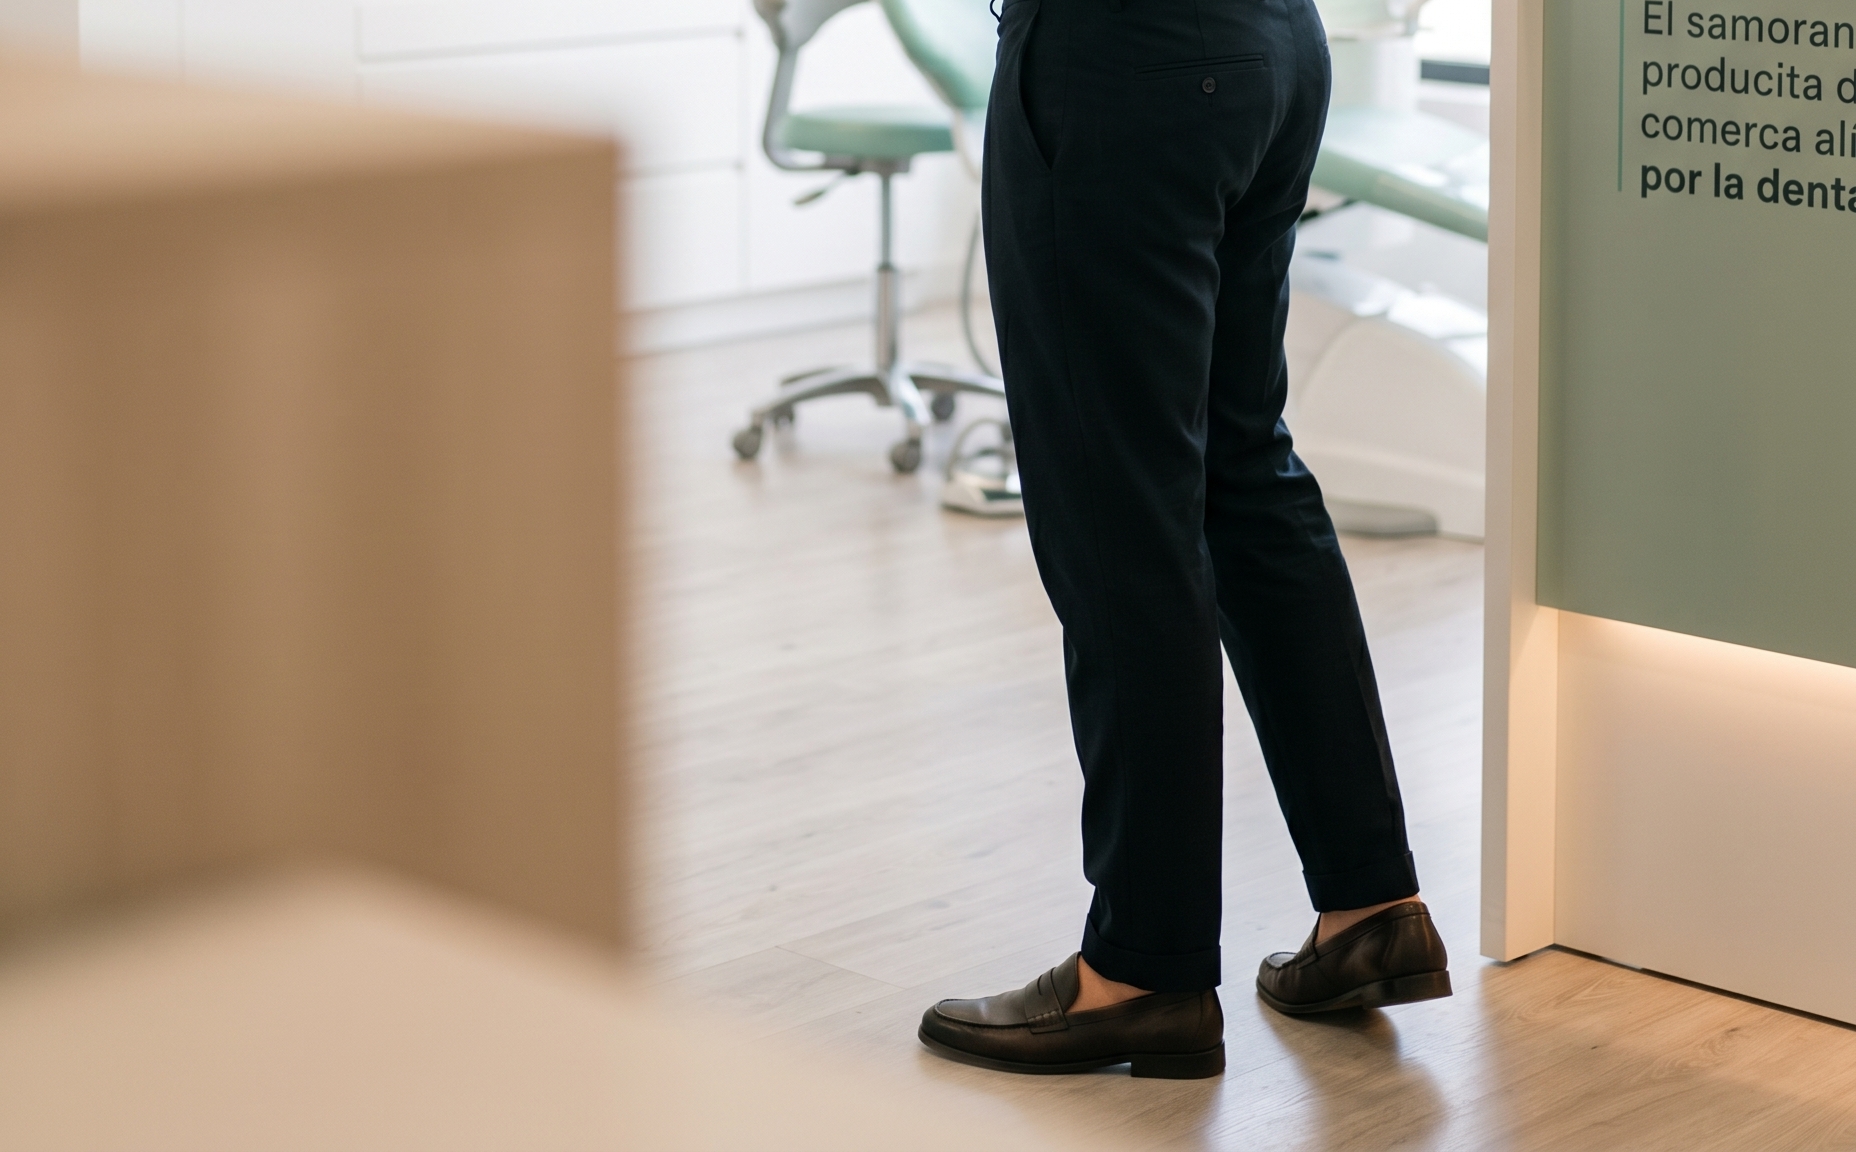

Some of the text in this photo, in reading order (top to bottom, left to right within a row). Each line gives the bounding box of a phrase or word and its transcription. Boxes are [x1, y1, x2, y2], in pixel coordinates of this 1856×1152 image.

[1644, 0, 1854, 50] El samoran
[1643, 56, 1822, 101] producita
[1641, 113, 1801, 153] comerca
[1641, 165, 1702, 199] por
[1714, 162, 1744, 200] la
